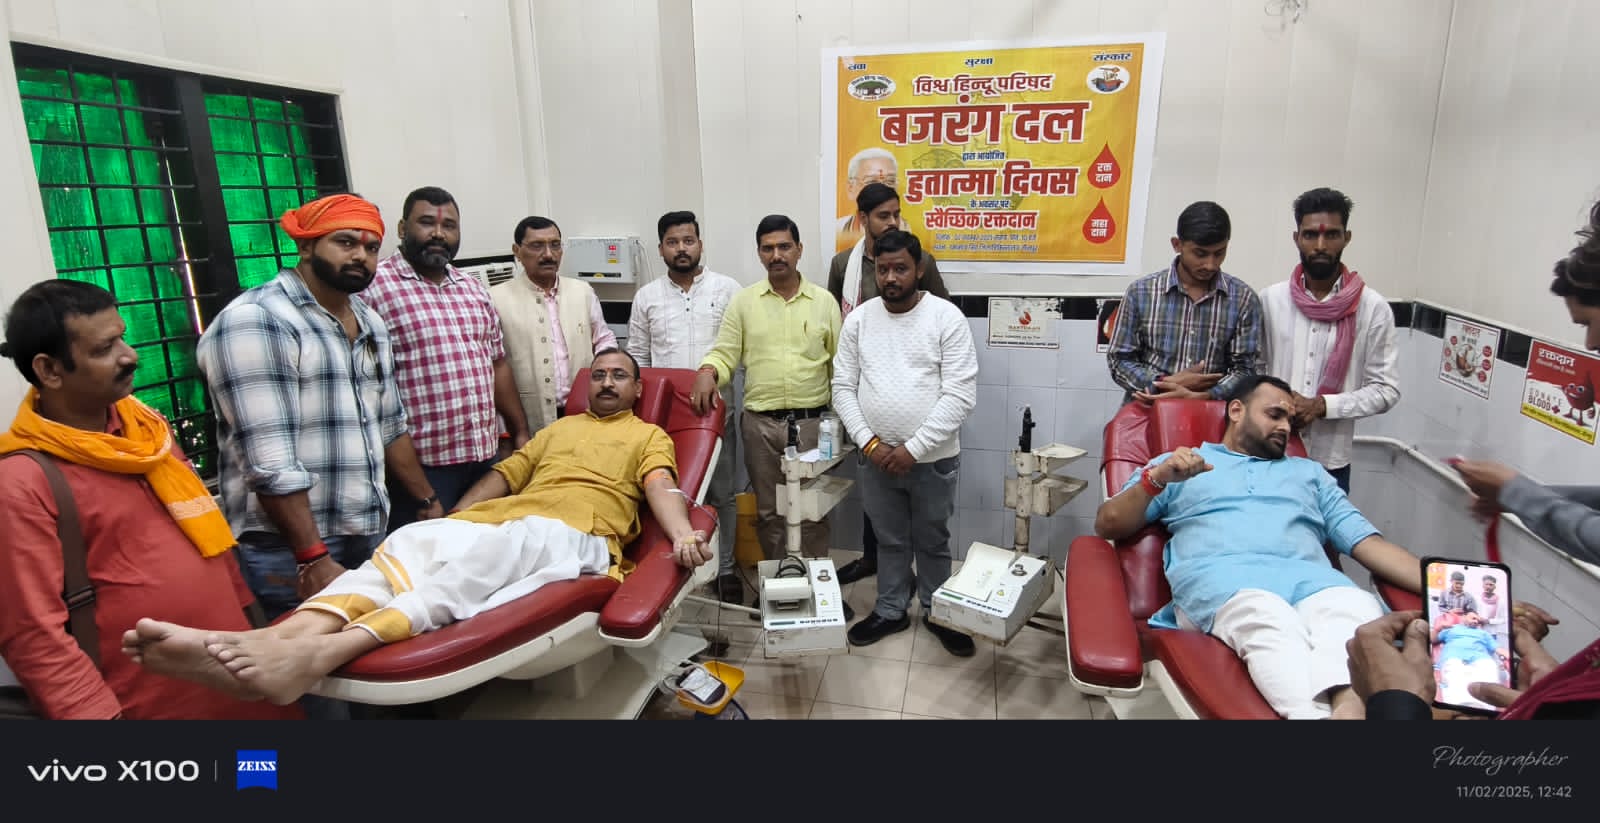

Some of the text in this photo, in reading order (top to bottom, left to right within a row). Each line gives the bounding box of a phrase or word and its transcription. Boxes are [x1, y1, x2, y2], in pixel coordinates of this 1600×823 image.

[965, 58, 993, 67] सुरक्षा
[1094, 52, 1131, 61] संस्कार
[915, 73, 1053, 96] विश्व हिन्दू परिषद
[879, 94, 1090, 144] बजरंग दल
[905, 161, 1079, 202] हुतात्मा दिवस
[925, 207, 1038, 228] स्वैच्छिक रक्तदान
[1528, 395, 1552, 411] BLOOD
